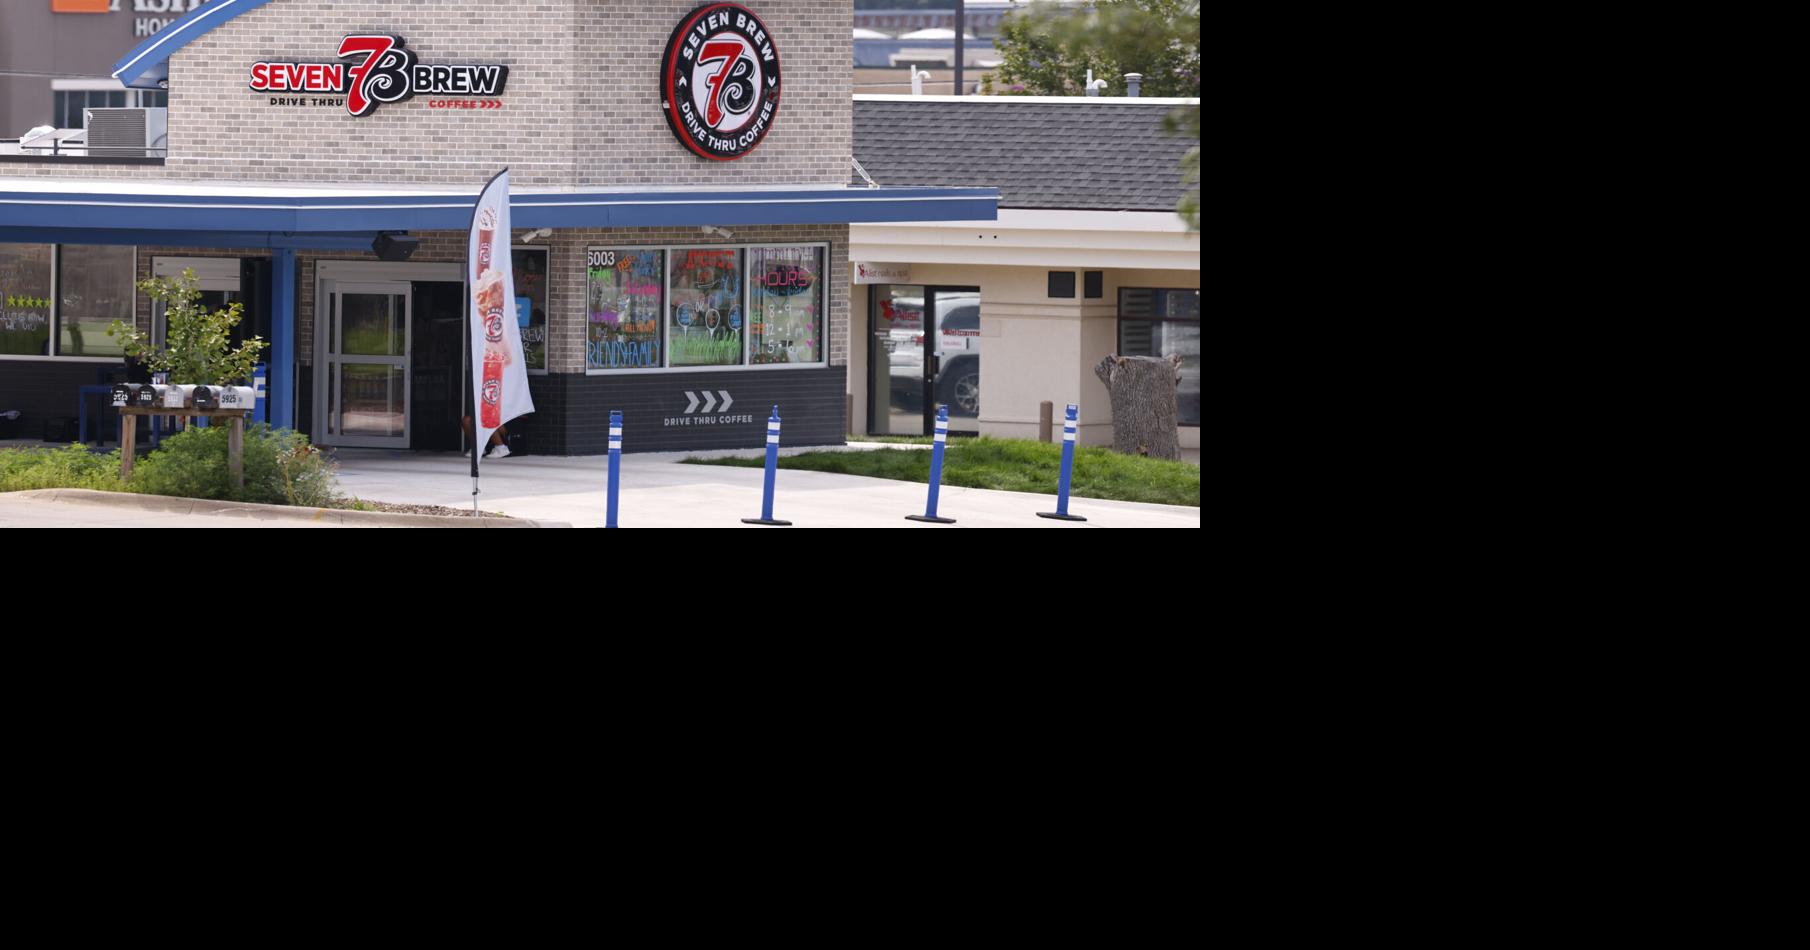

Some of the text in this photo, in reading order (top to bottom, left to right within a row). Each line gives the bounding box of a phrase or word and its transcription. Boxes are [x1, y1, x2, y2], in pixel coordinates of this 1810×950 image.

[682, 12, 775, 62] SEVEN BREW
[250, 63, 344, 92] SEVEN
[413, 66, 500, 94] BREW
[269, 97, 477, 109] DRIVE THRU COFFEE
[681, 101, 774, 152] DRIVE THRU COFFEE
[588, 251, 616, 266] 6003
[221, 394, 237, 404] 5925
[664, 414, 753, 427] DRIVE THRU COFFEE
